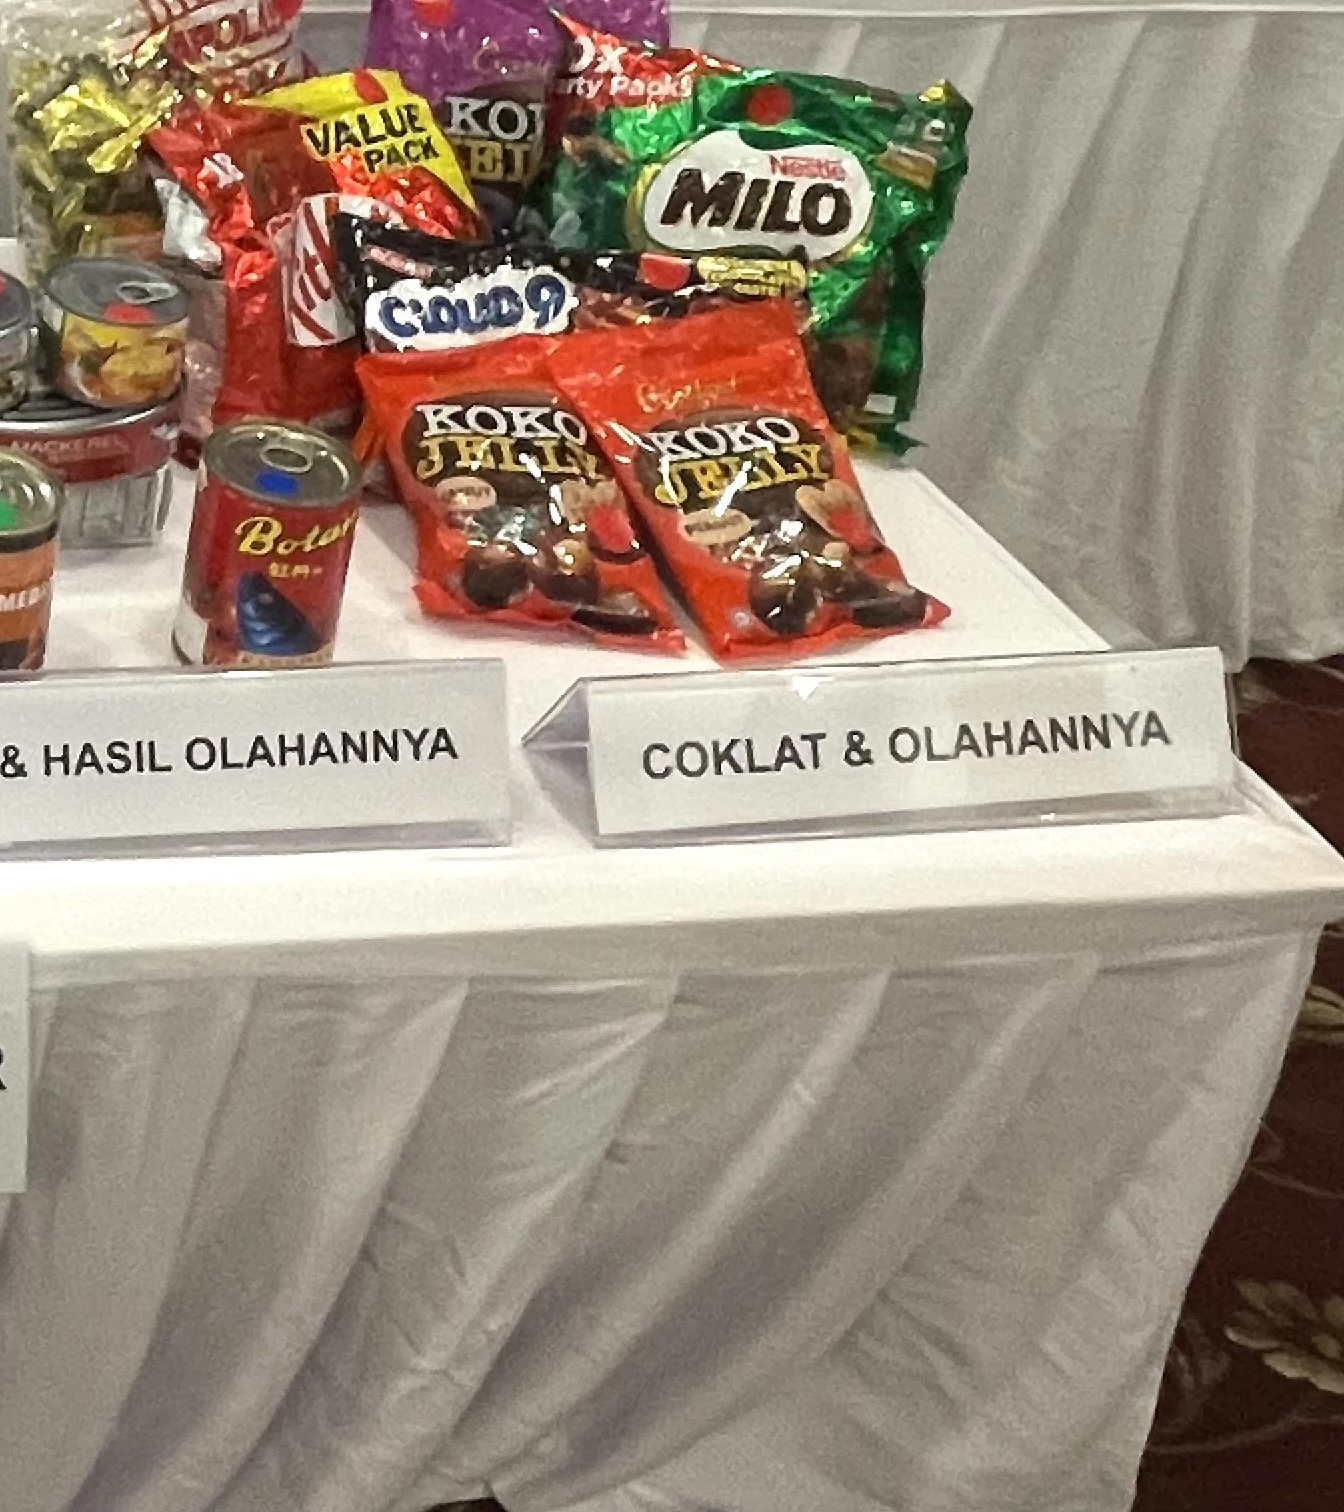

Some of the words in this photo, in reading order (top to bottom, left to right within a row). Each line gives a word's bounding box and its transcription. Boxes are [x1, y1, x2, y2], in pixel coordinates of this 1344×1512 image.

[305, 103, 426, 158] VALUE
[364, 137, 441, 175] PACK
[661, 169, 853, 238] MILO
[416, 403, 588, 444] KOKO
[646, 416, 799, 463] KOKO
[416, 436, 607, 484] JELLY
[653, 443, 835, 509] JELLY
[0, 744, 29, 779] &
[42, 738, 174, 777] HASIL
[185, 727, 459, 770] OLAHANNYA
[641, 732, 826, 780] COKLAT
[843, 732, 875, 767] &
[889, 710, 1172, 764] OLAHANNYA
